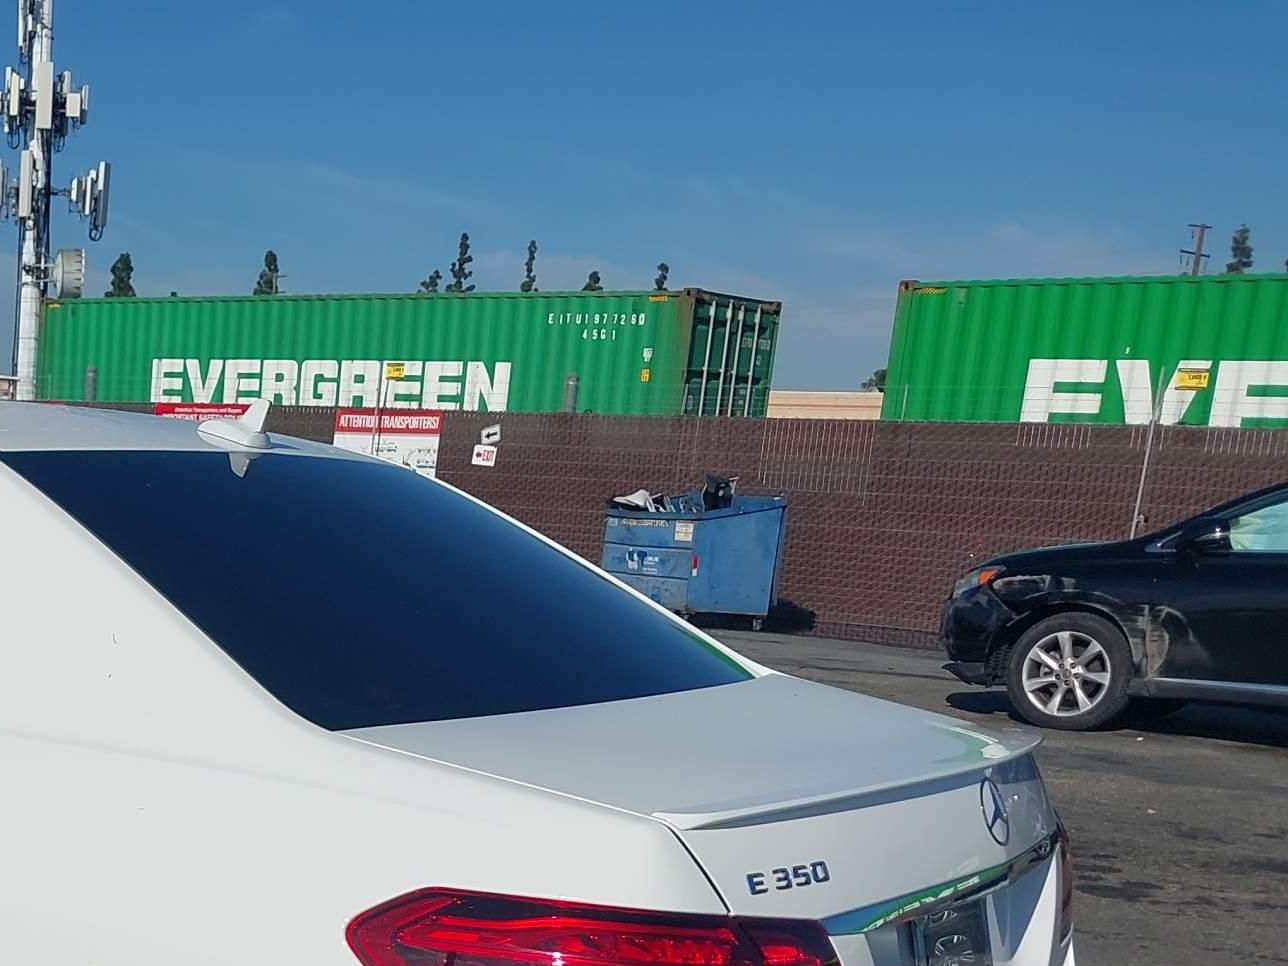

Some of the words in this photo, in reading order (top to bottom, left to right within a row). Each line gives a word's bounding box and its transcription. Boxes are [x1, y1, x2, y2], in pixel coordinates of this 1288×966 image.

[150, 358, 512, 412] EVERGREEN
[339, 414, 379, 428] ATTENTION
[380, 415, 441, 430] TRANSPORTERS!
[481, 449, 495, 462] EXIT
[746, 871, 769, 896] E
[771, 860, 831, 891] 350
